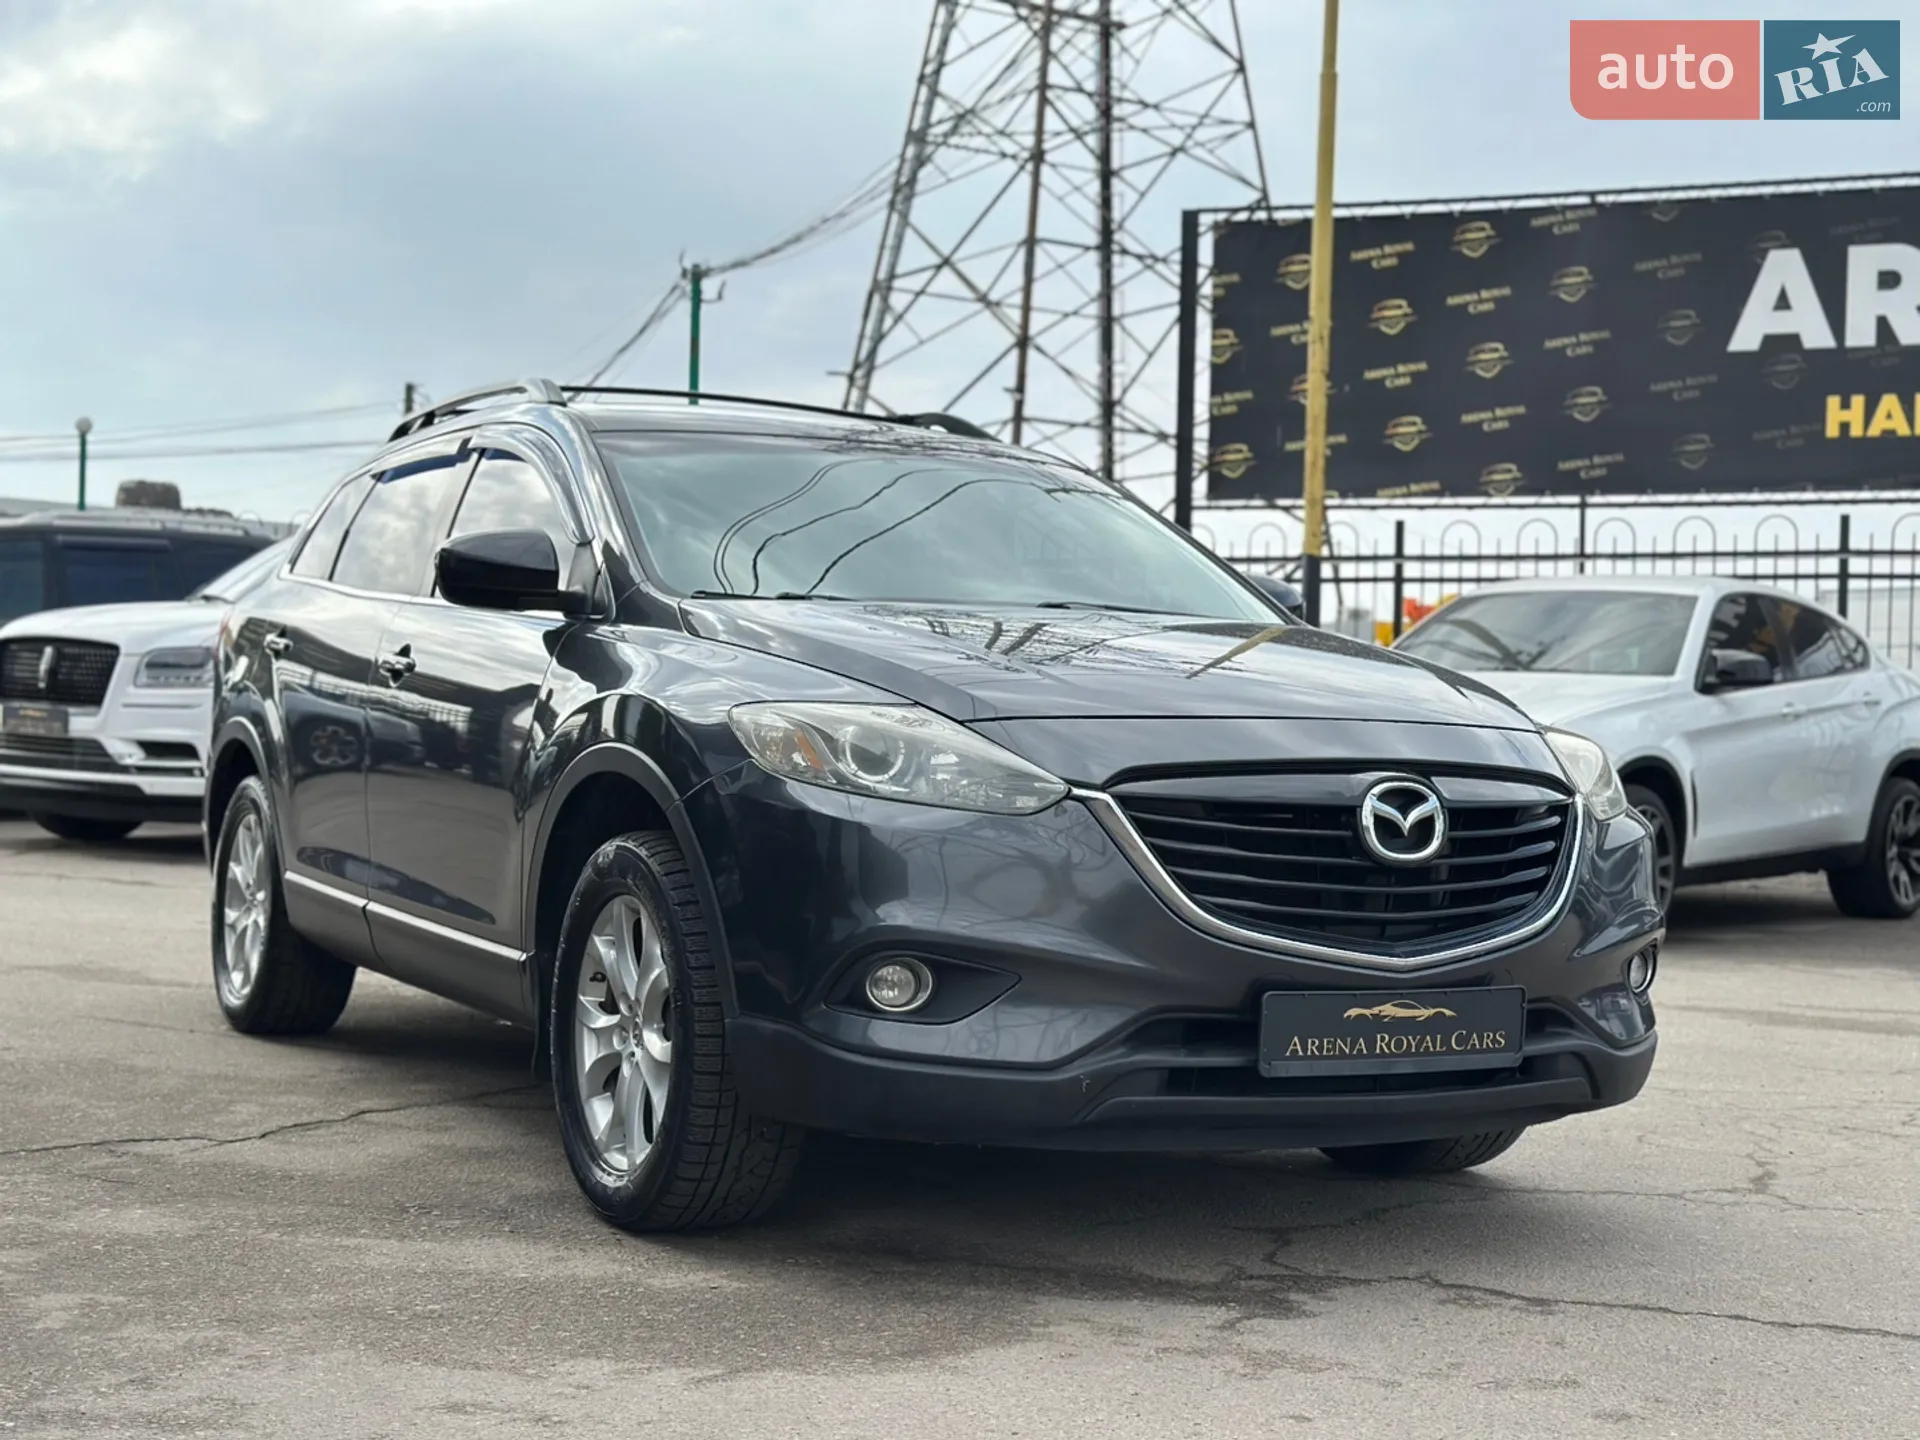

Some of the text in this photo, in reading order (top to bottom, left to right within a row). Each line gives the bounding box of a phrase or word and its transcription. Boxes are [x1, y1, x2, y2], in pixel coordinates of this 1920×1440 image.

[1285, 1030, 1506, 1056] ARENA ROYAL CARS
